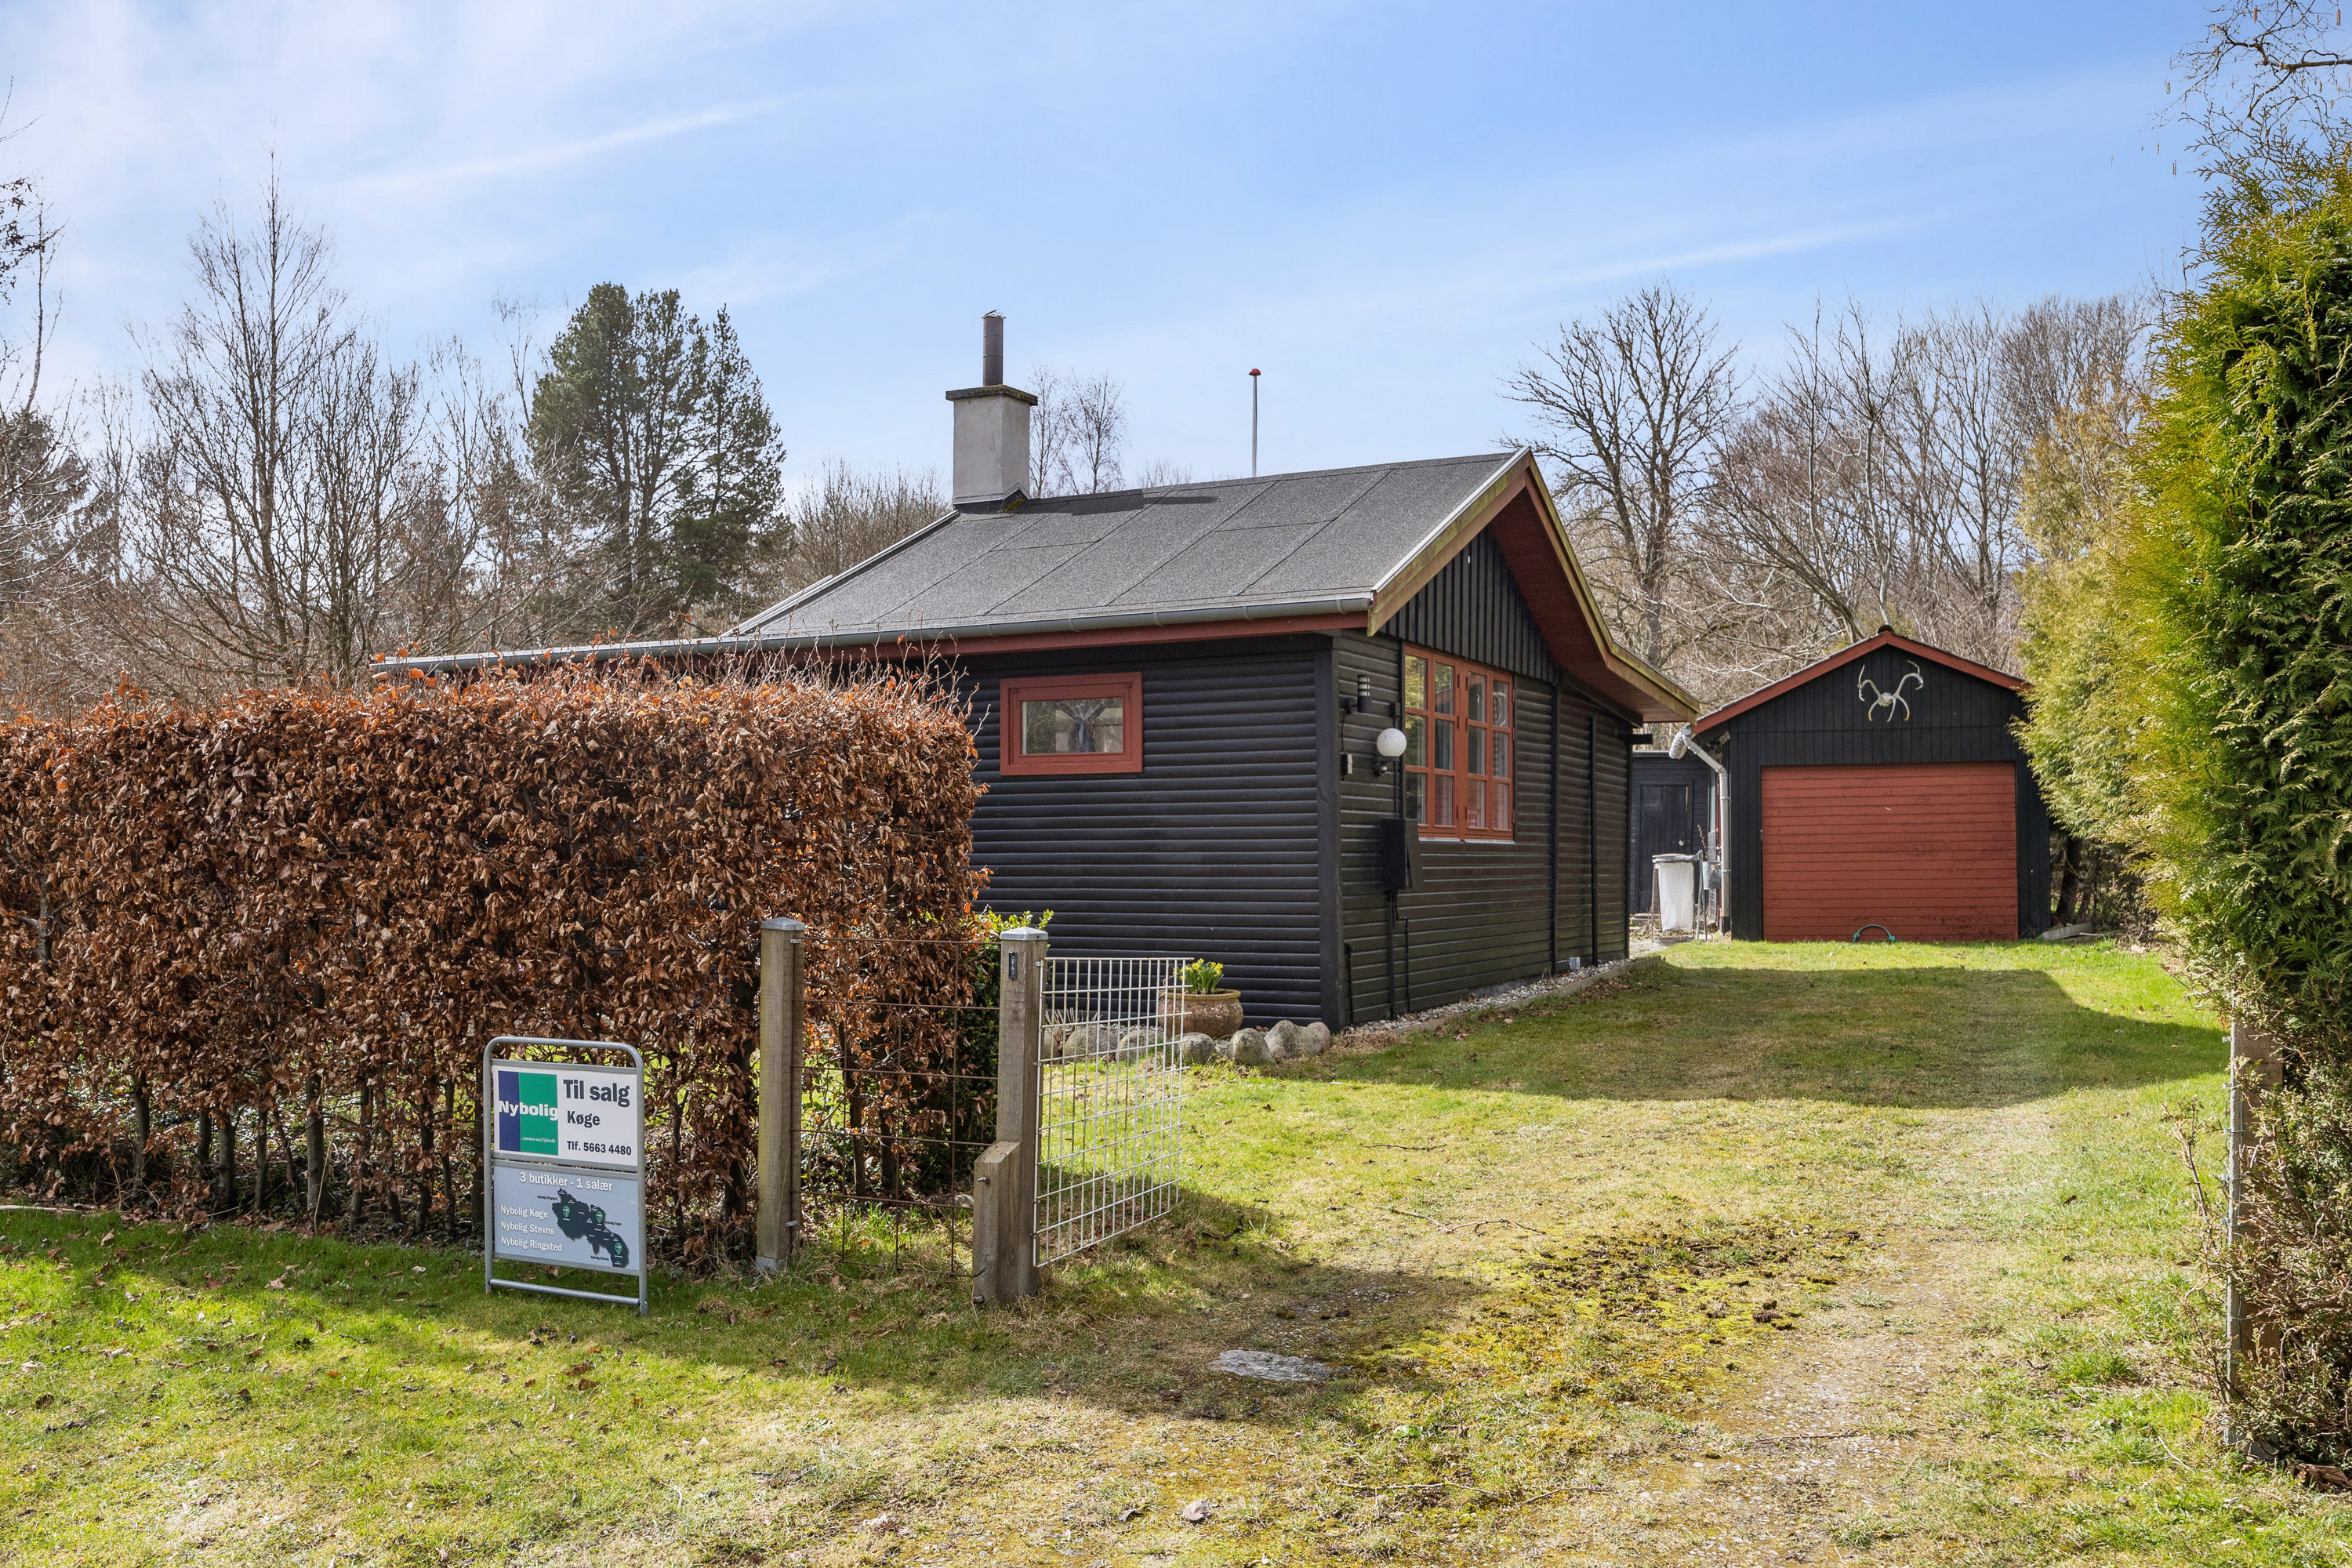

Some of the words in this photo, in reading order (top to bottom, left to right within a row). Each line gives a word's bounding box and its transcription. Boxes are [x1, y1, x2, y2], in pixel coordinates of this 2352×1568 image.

[563, 1080, 584, 1099] Til
[590, 1083, 630, 1108] salg
[499, 1100, 558, 1121] Nybolig
[567, 1110, 601, 1128] Køge
[567, 1141, 581, 1151] Tlf.
[583, 1142, 606, 1153] 5663
[608, 1145, 632, 1156] 4480
[520, 1171, 526, 1182] 3
[529, 1172, 568, 1187] butikker
[576, 1178, 583, 1189] 1
[586, 1180, 613, 1192] salær
[500, 1205, 528, 1217] Nybolig
[529, 1207, 548, 1220] Køge
[501, 1221, 528, 1233] Nybolig
[530, 1223, 555, 1236] Stevns
[501, 1236, 528, 1249] Nybolig
[530, 1239, 563, 1252] Ringsted
